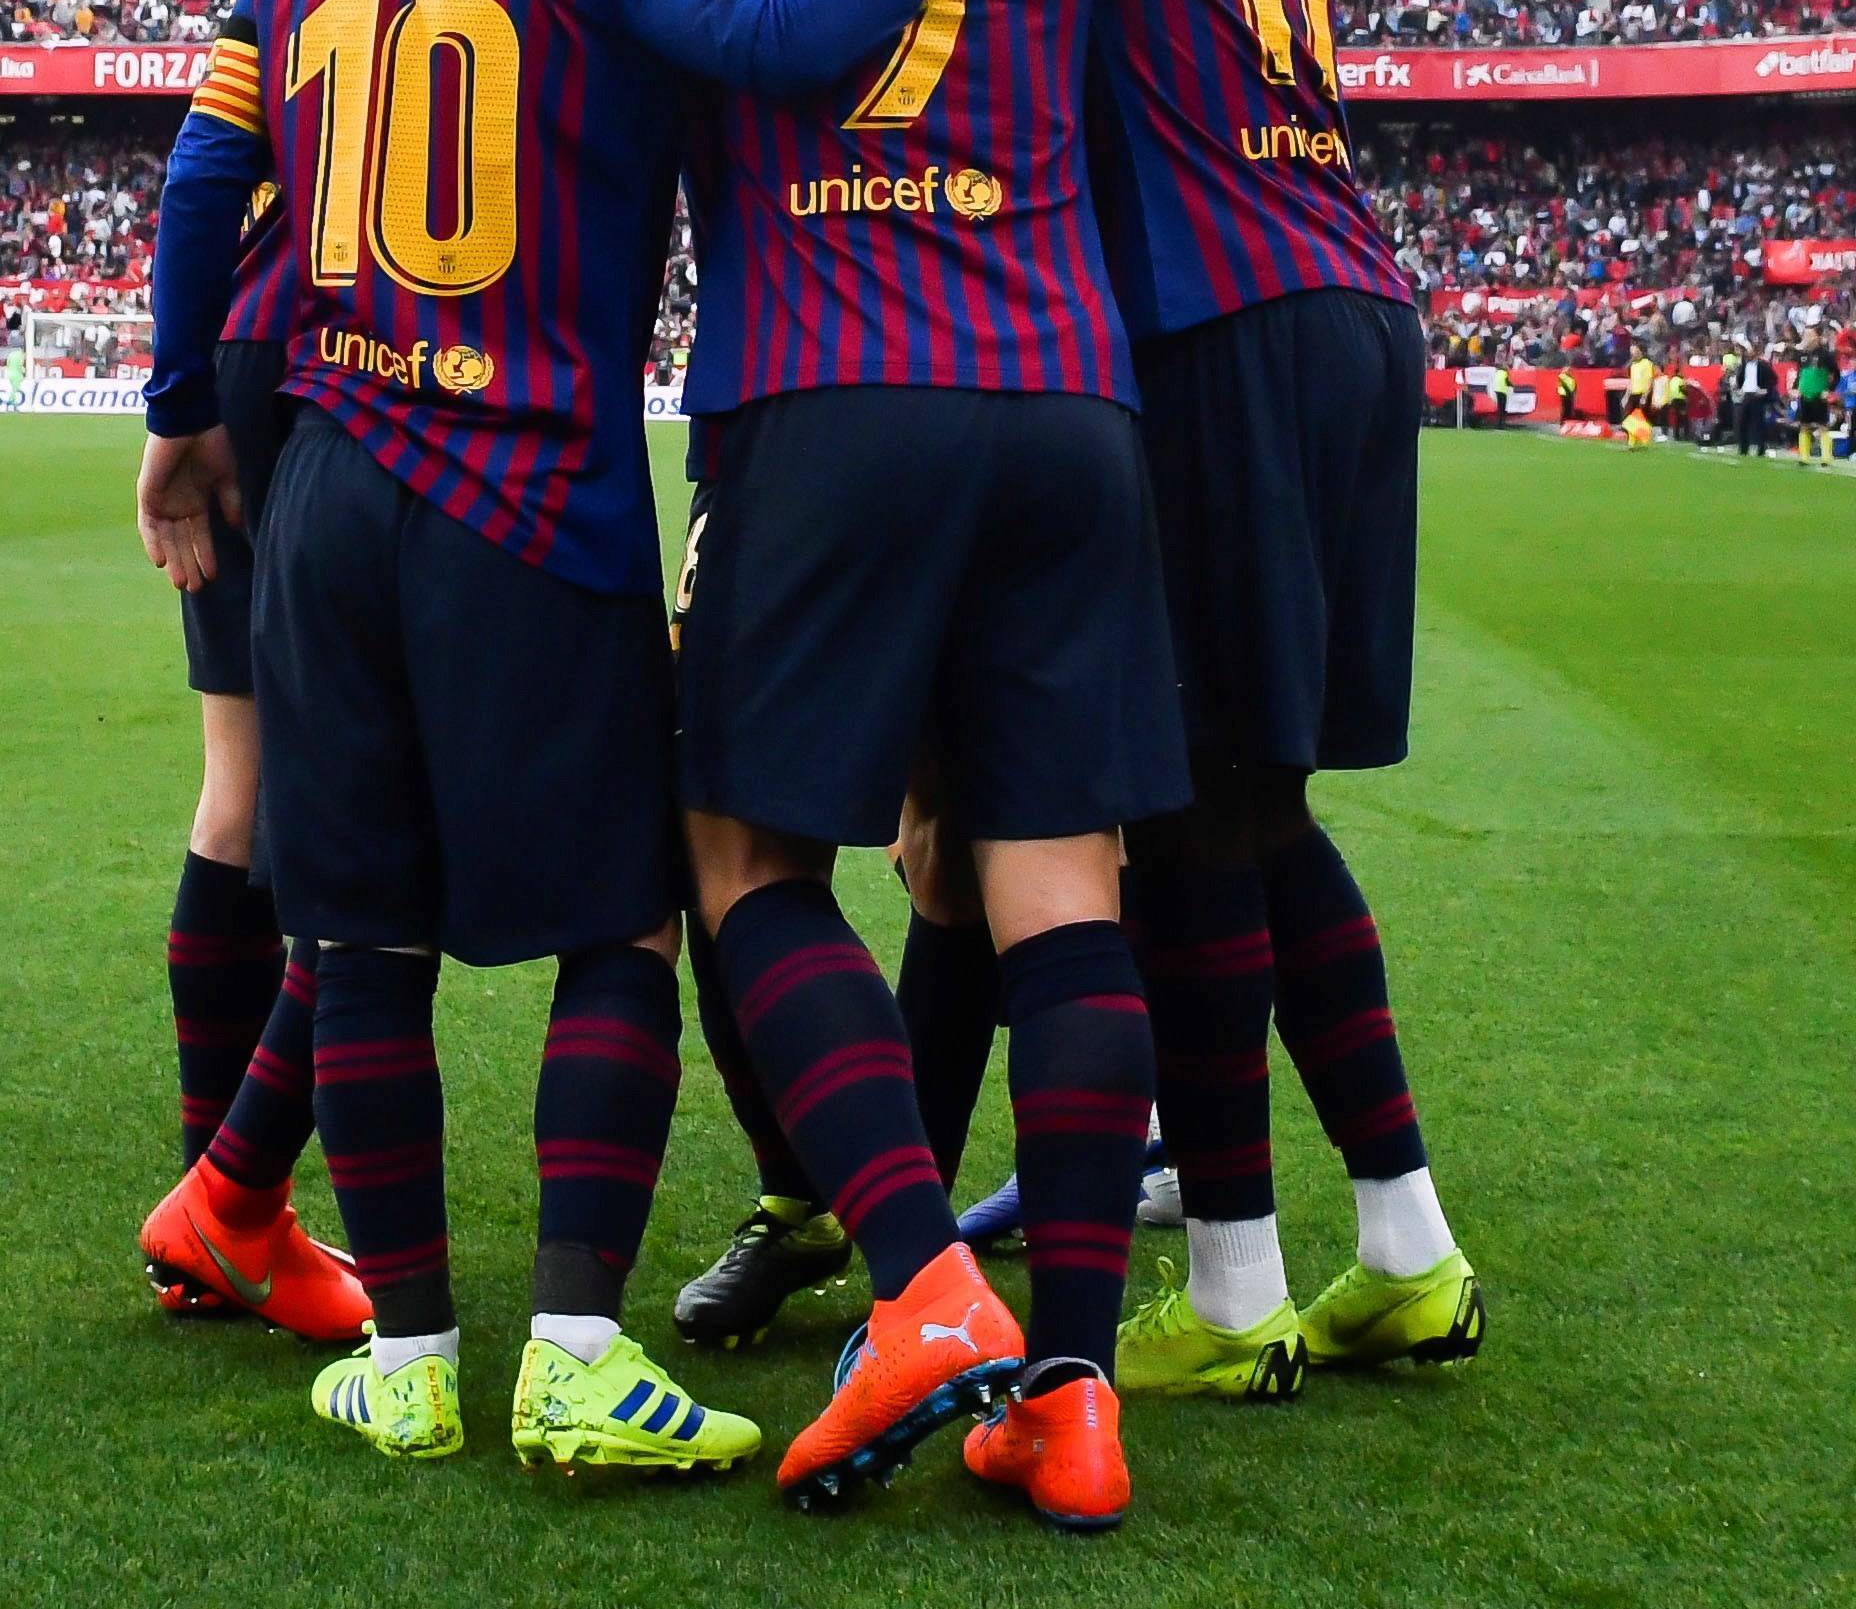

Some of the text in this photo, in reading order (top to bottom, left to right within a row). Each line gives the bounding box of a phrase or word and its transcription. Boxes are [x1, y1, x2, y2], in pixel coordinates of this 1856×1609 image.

[94, 51, 210, 88] FORZA
[1337, 55, 1411, 87] erfx
[790, 164, 939, 217] unicef
[320, 327, 428, 389] unicef
